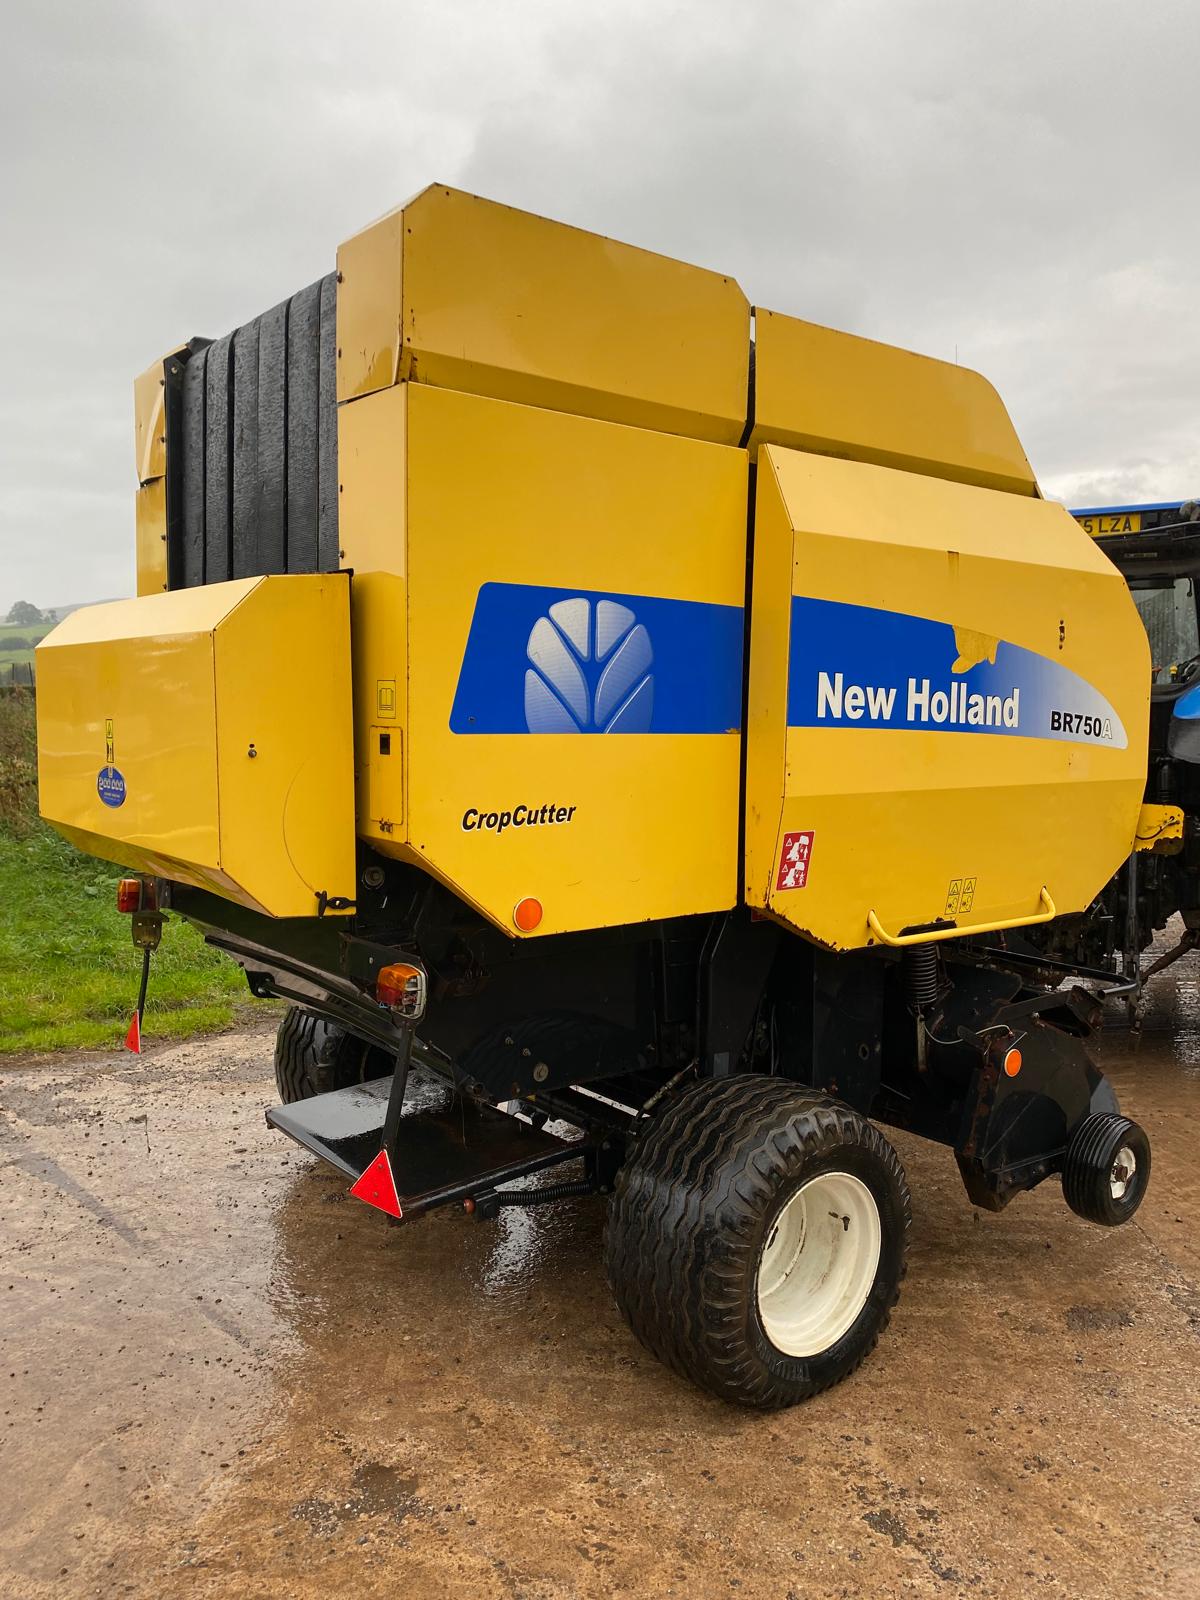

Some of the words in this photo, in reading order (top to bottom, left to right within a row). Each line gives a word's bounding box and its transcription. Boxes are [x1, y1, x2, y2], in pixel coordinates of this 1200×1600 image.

[1098, 517, 1132, 533] LZA
[817, 671, 897, 721] New
[907, 677, 1020, 728] Holland
[1050, 710, 1113, 740] BR750A
[462, 803, 577, 834] CropCutter
